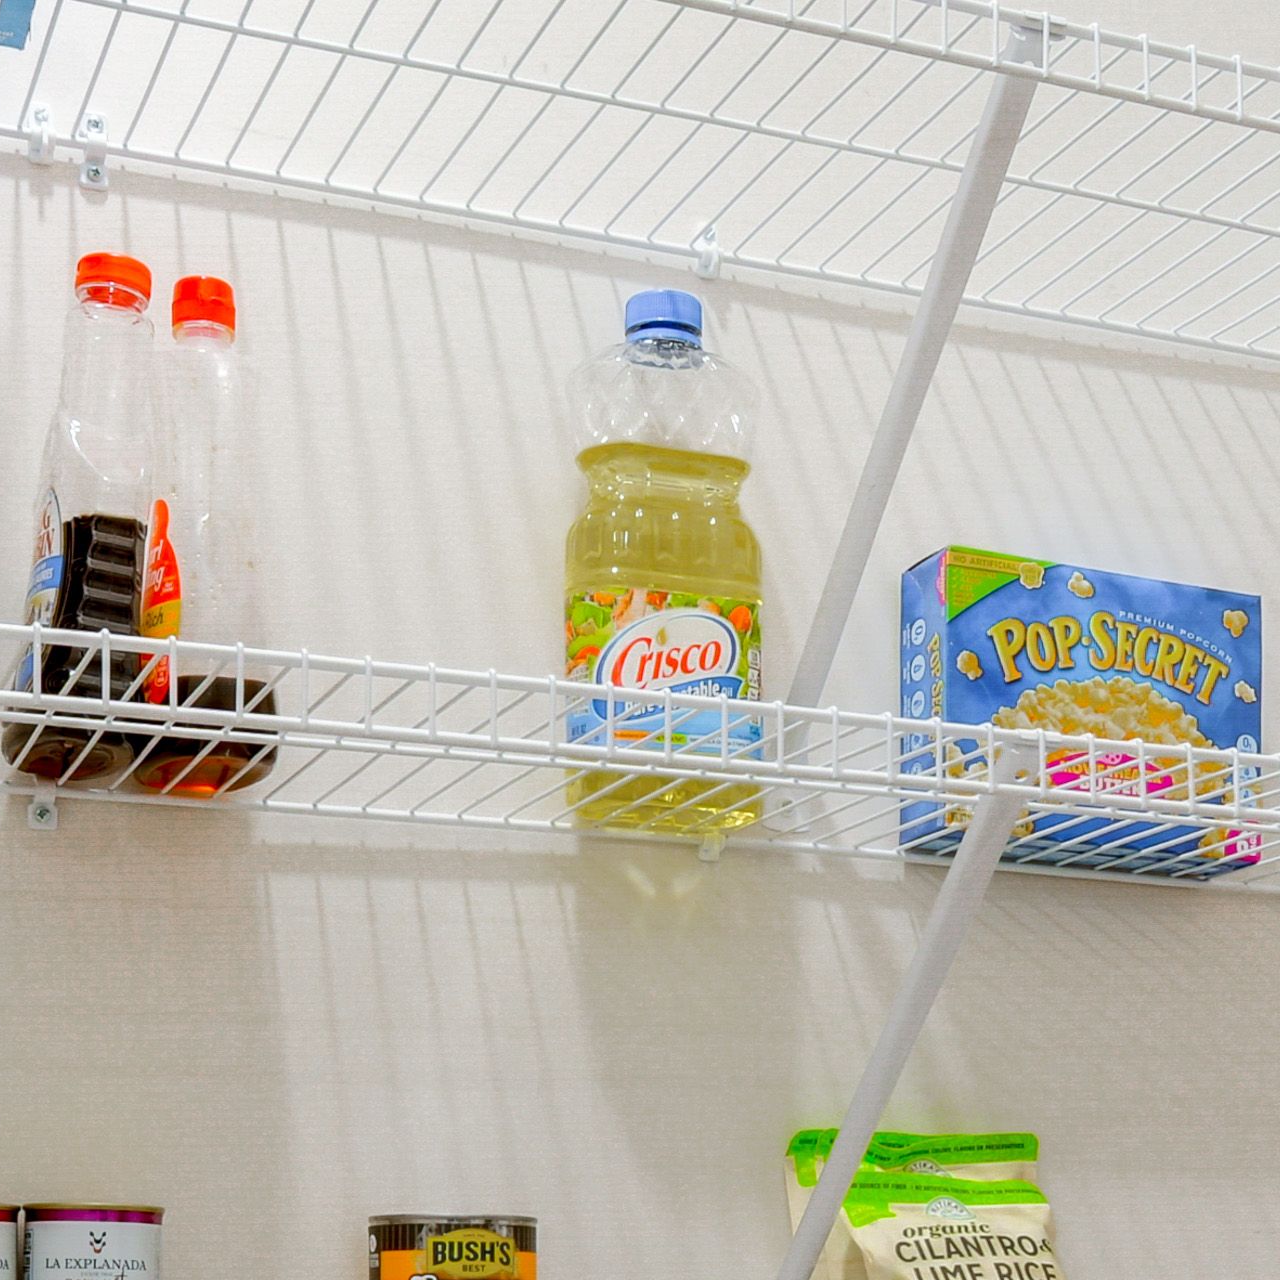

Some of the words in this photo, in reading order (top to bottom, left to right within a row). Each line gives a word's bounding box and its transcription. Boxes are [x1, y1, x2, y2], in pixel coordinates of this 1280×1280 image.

[1119, 611, 1175, 632] PREMIUM
[1179, 628, 1234, 664] POPCORN
[611, 637, 722, 691] Crisco
[903, 1222, 991, 1241] organic
[432, 1241, 511, 1266] BUSH'S
[894, 1235, 1038, 1263] CILANTRO
[45, 1258, 61, 1269] LA
[65, 1258, 147, 1271] EXPLANADA
[462, 1264, 486, 1273] BEST
